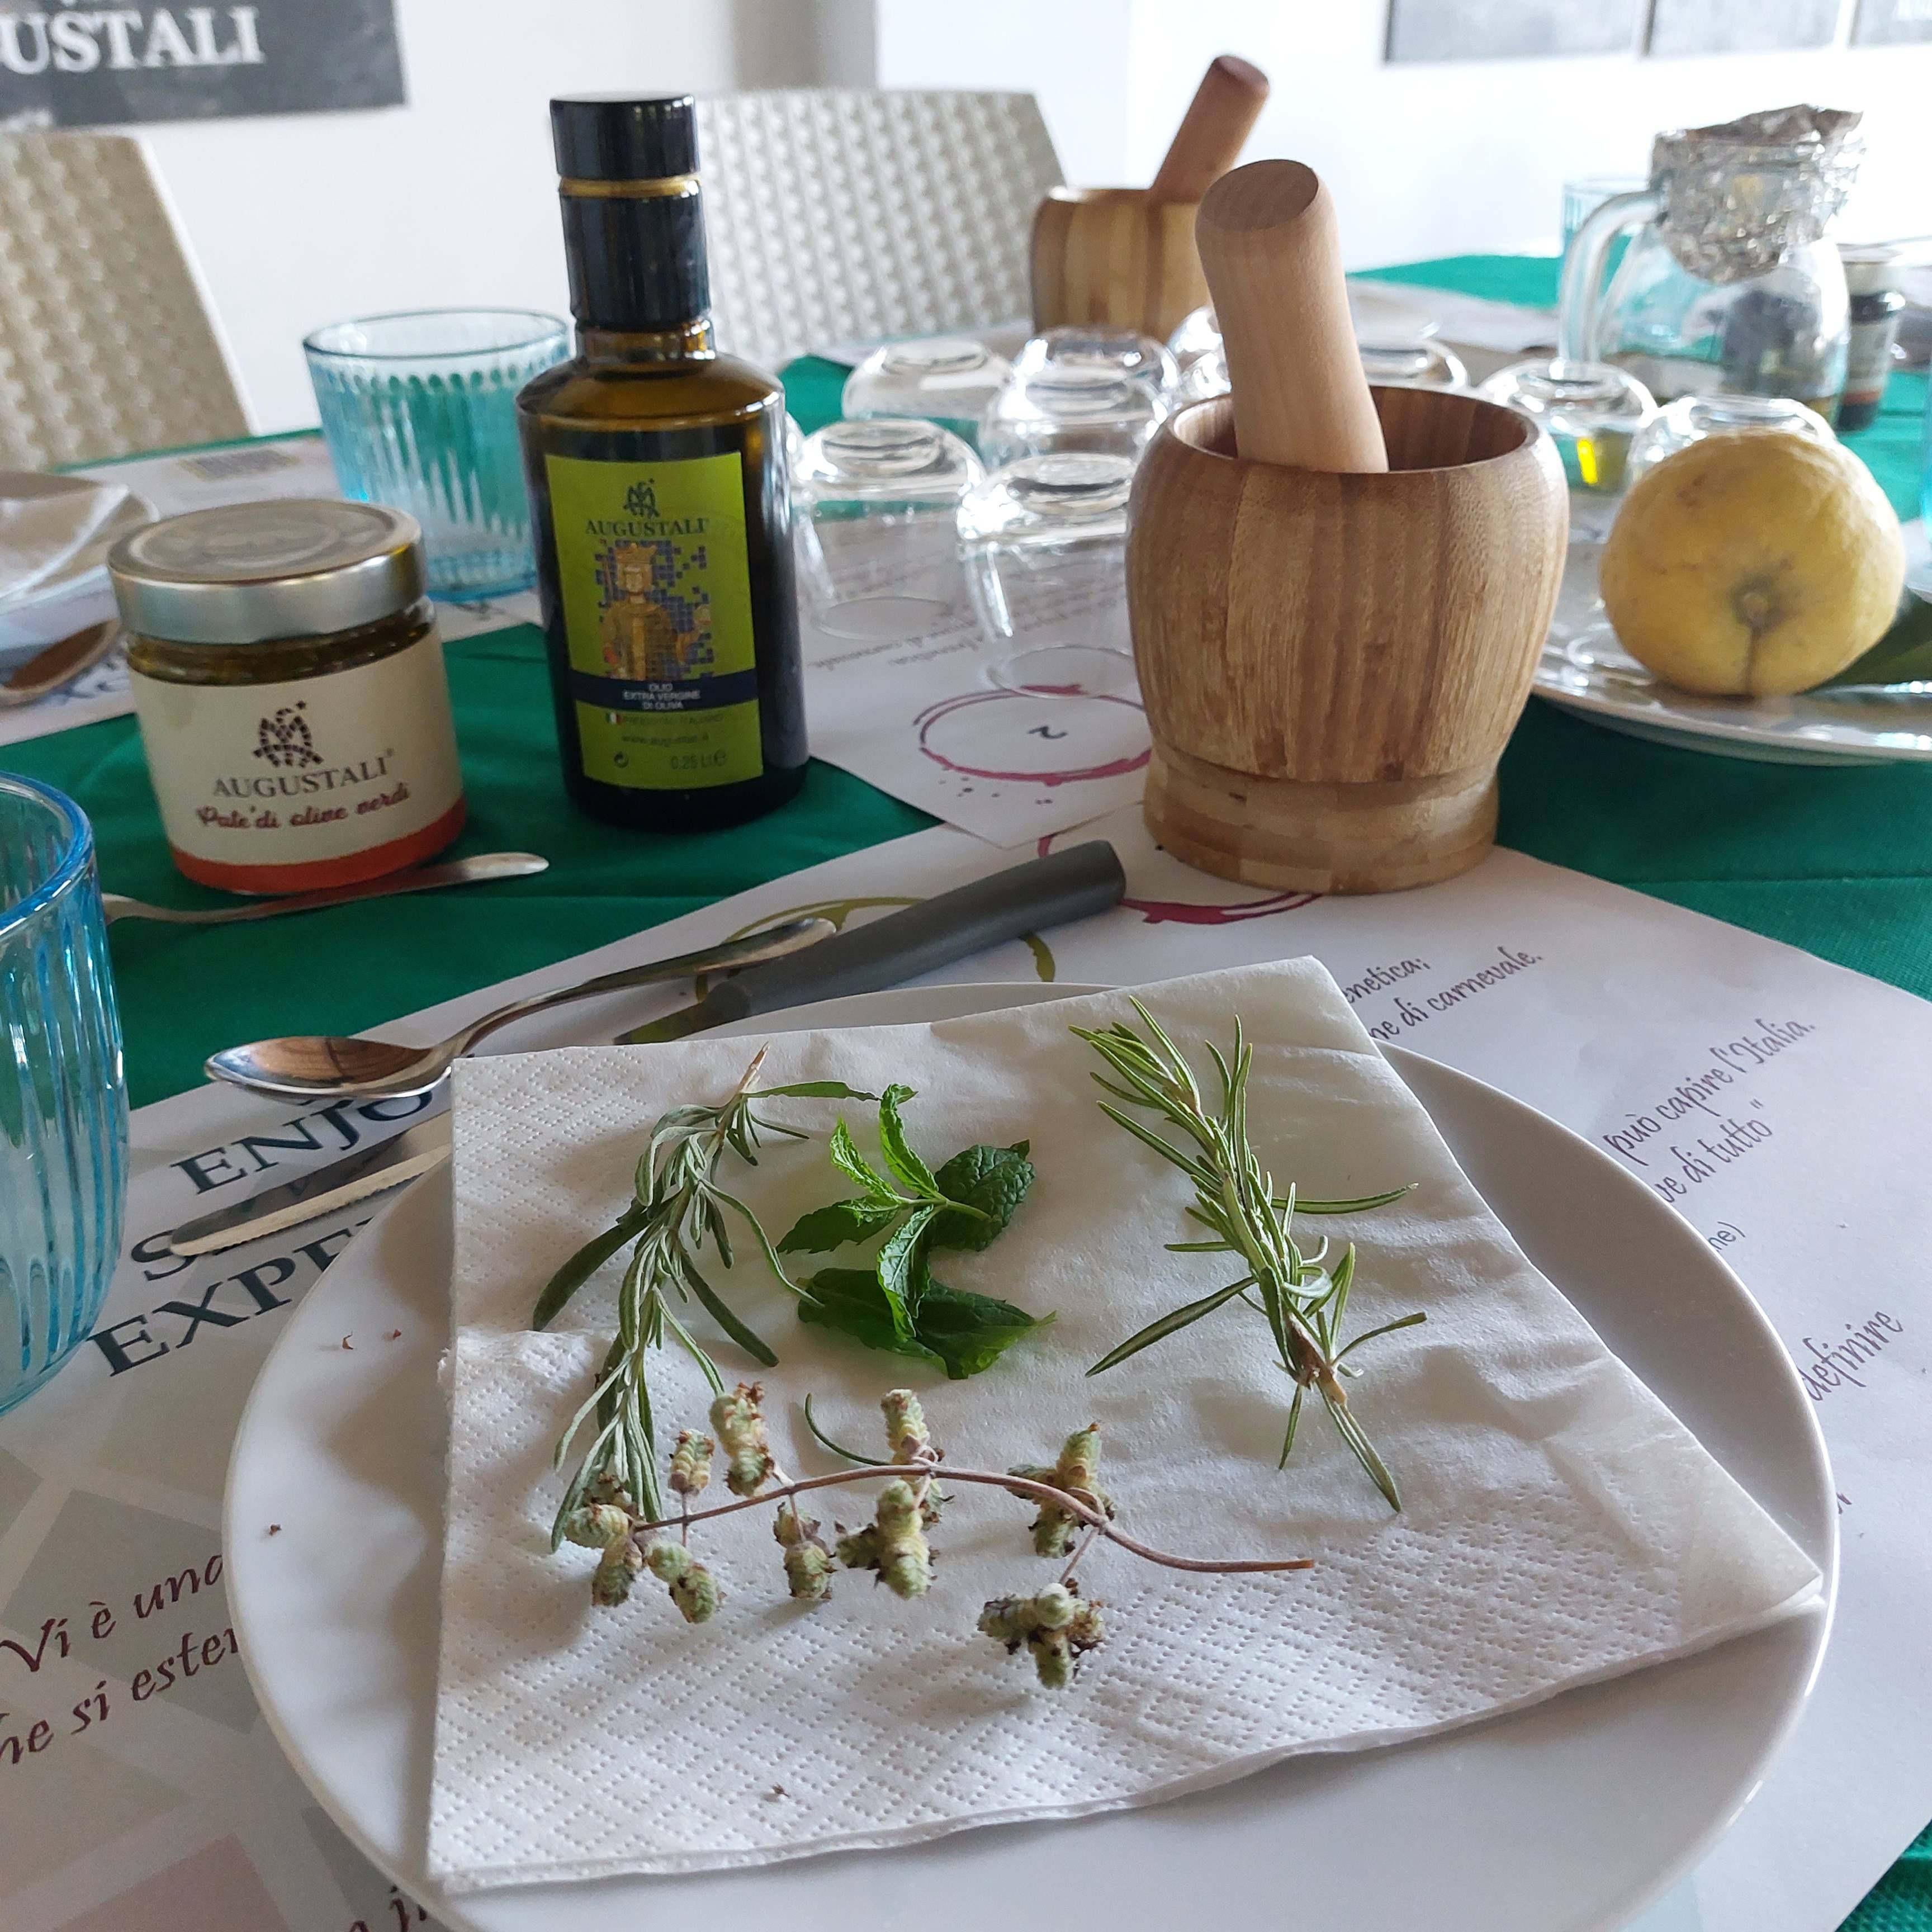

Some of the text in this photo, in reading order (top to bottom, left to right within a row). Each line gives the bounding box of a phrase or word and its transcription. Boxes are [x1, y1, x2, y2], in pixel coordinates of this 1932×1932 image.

[585, 517, 705, 537] AUGUSTALI
[623, 689, 700, 701] EXTRA VERGINE
[648, 682, 673, 692] OLIO
[655, 700, 684, 711] OLIVA
[213, 756, 388, 798] AUGUSTALI
[1394, 996, 1429, 1026] di
[1427, 945, 1545, 1011] carnevale.
[1602, 1114, 1662, 1167] può
[1655, 1067, 1734, 1117] capire
[1669, 1145, 1716, 1183] di
[71, 1680, 110, 1735] si
